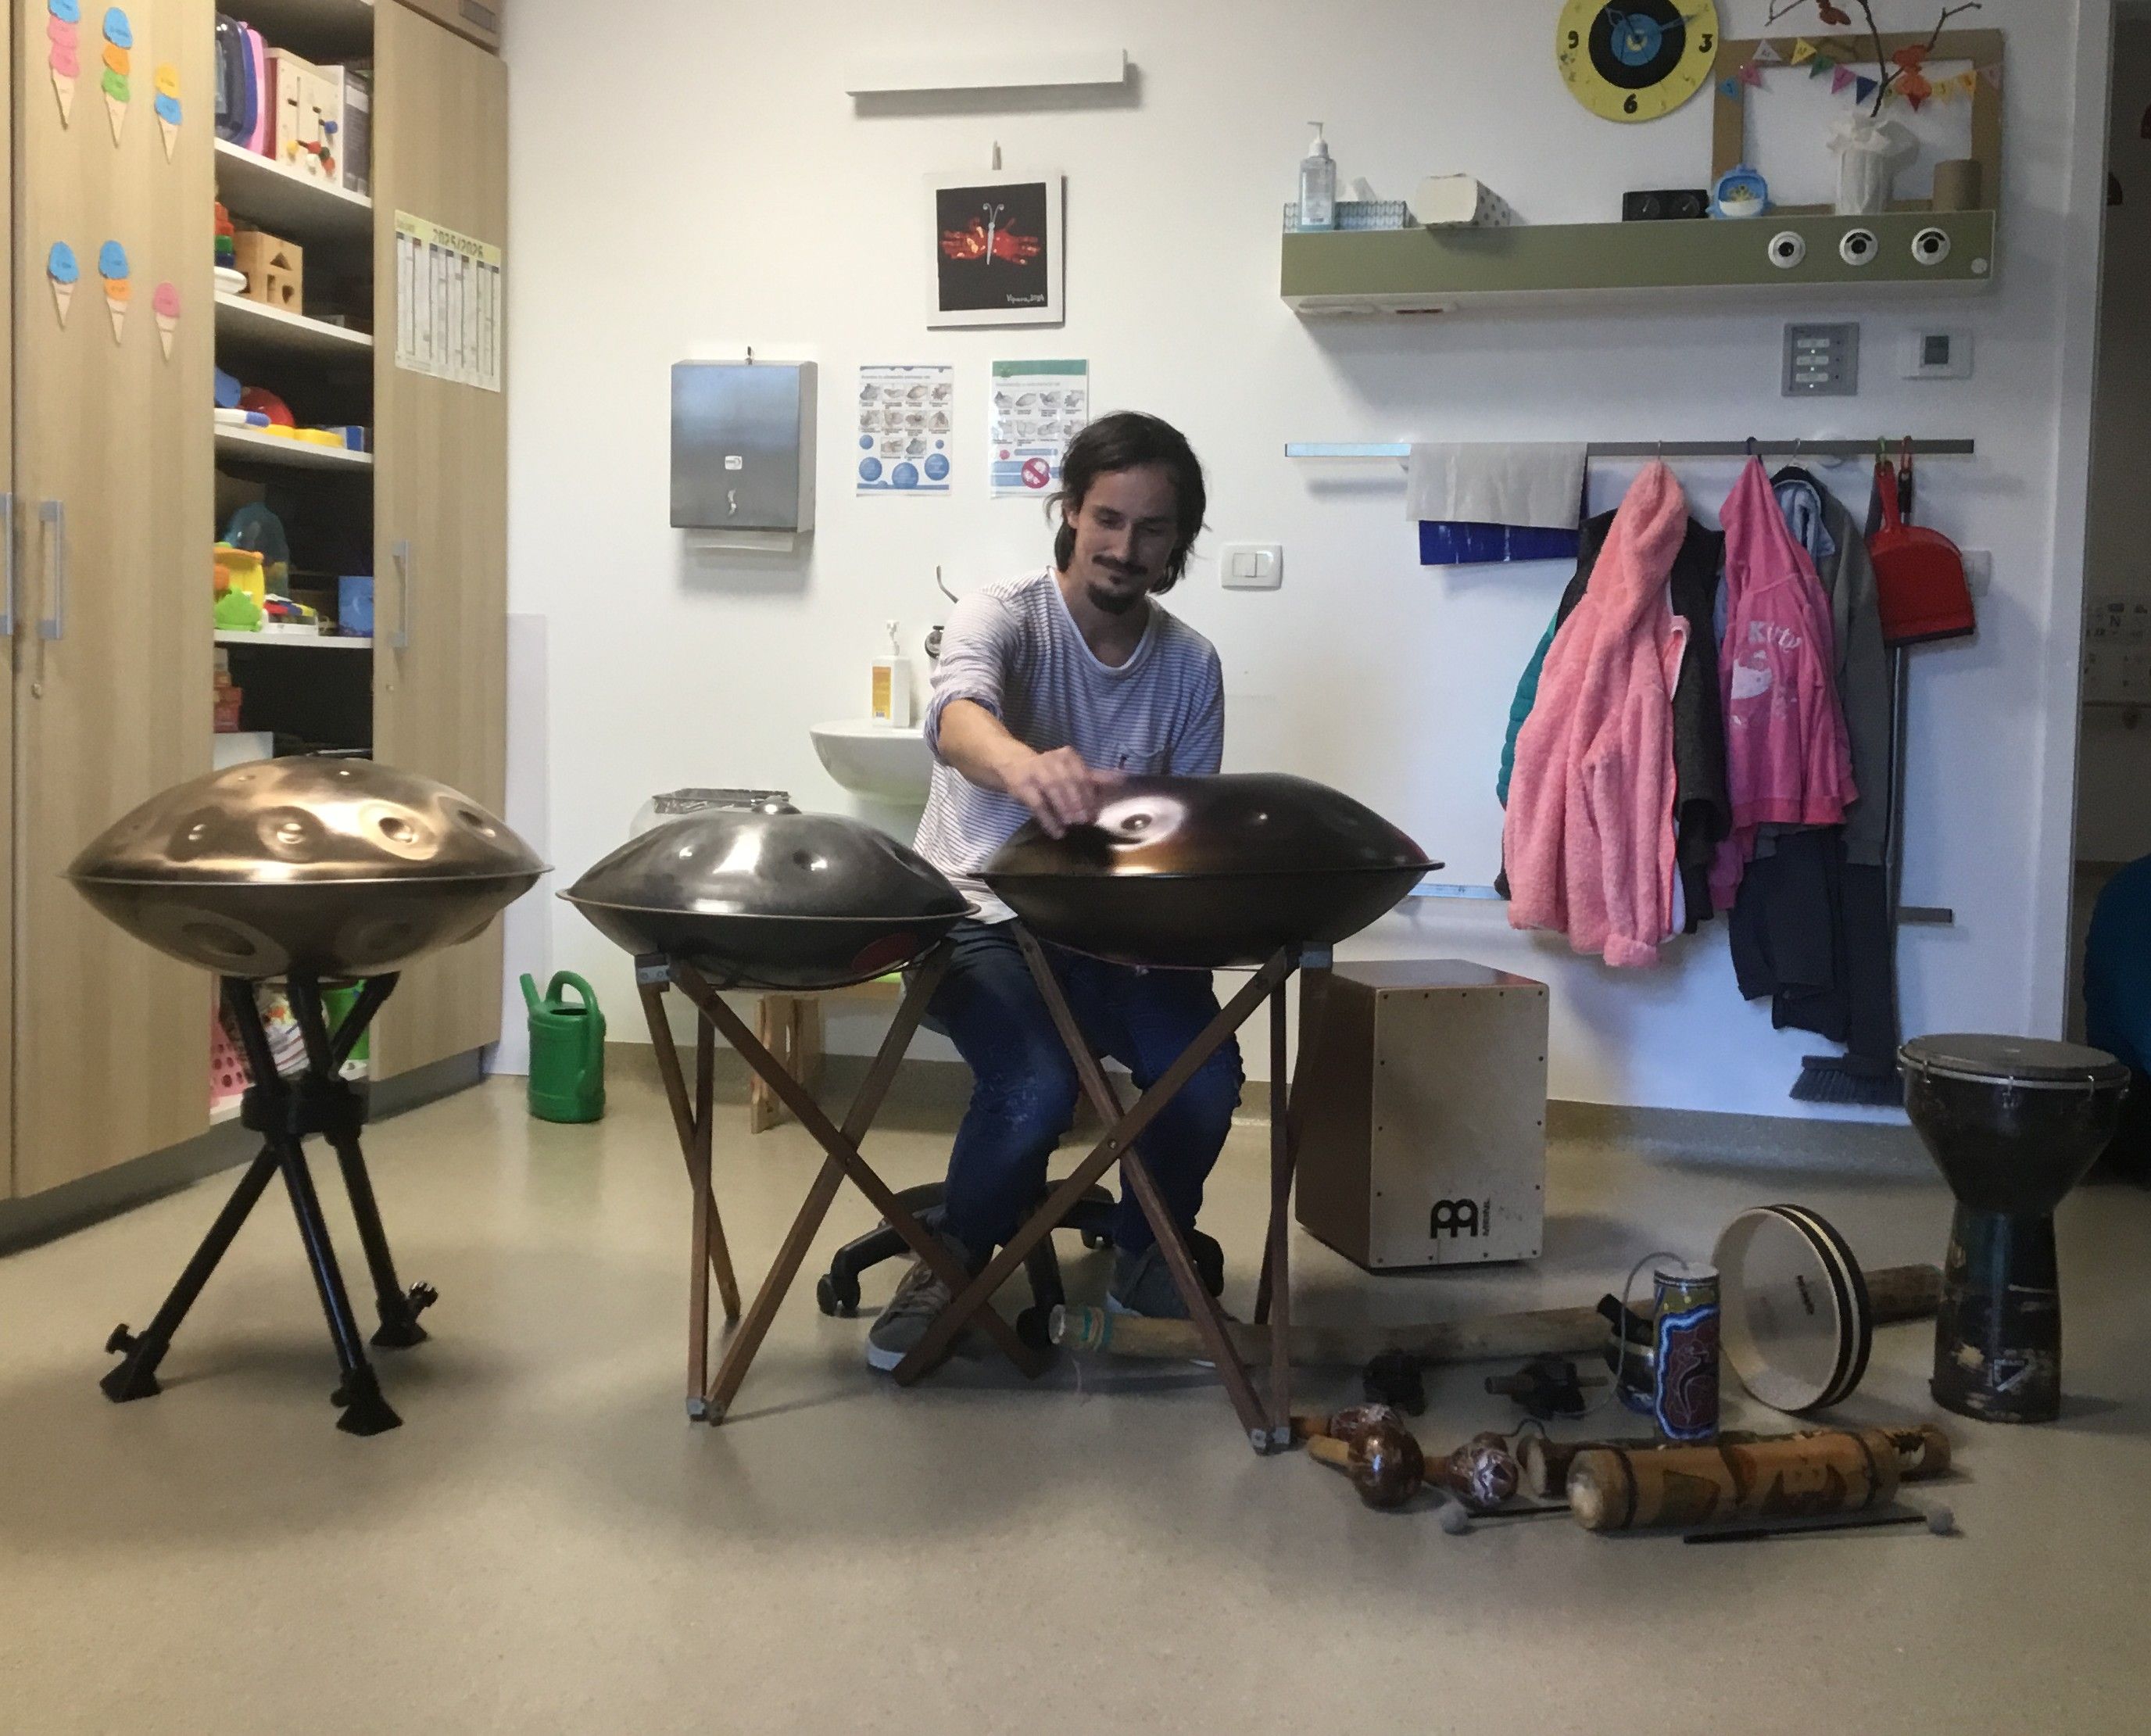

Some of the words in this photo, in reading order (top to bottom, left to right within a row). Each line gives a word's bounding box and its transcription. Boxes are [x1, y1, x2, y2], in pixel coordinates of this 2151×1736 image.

[1569, 30, 1579, 48] 9
[1698, 34, 1713, 52] 3
[1623, 93, 1637, 114] 6
[432, 228, 483, 258] 2025/2026
